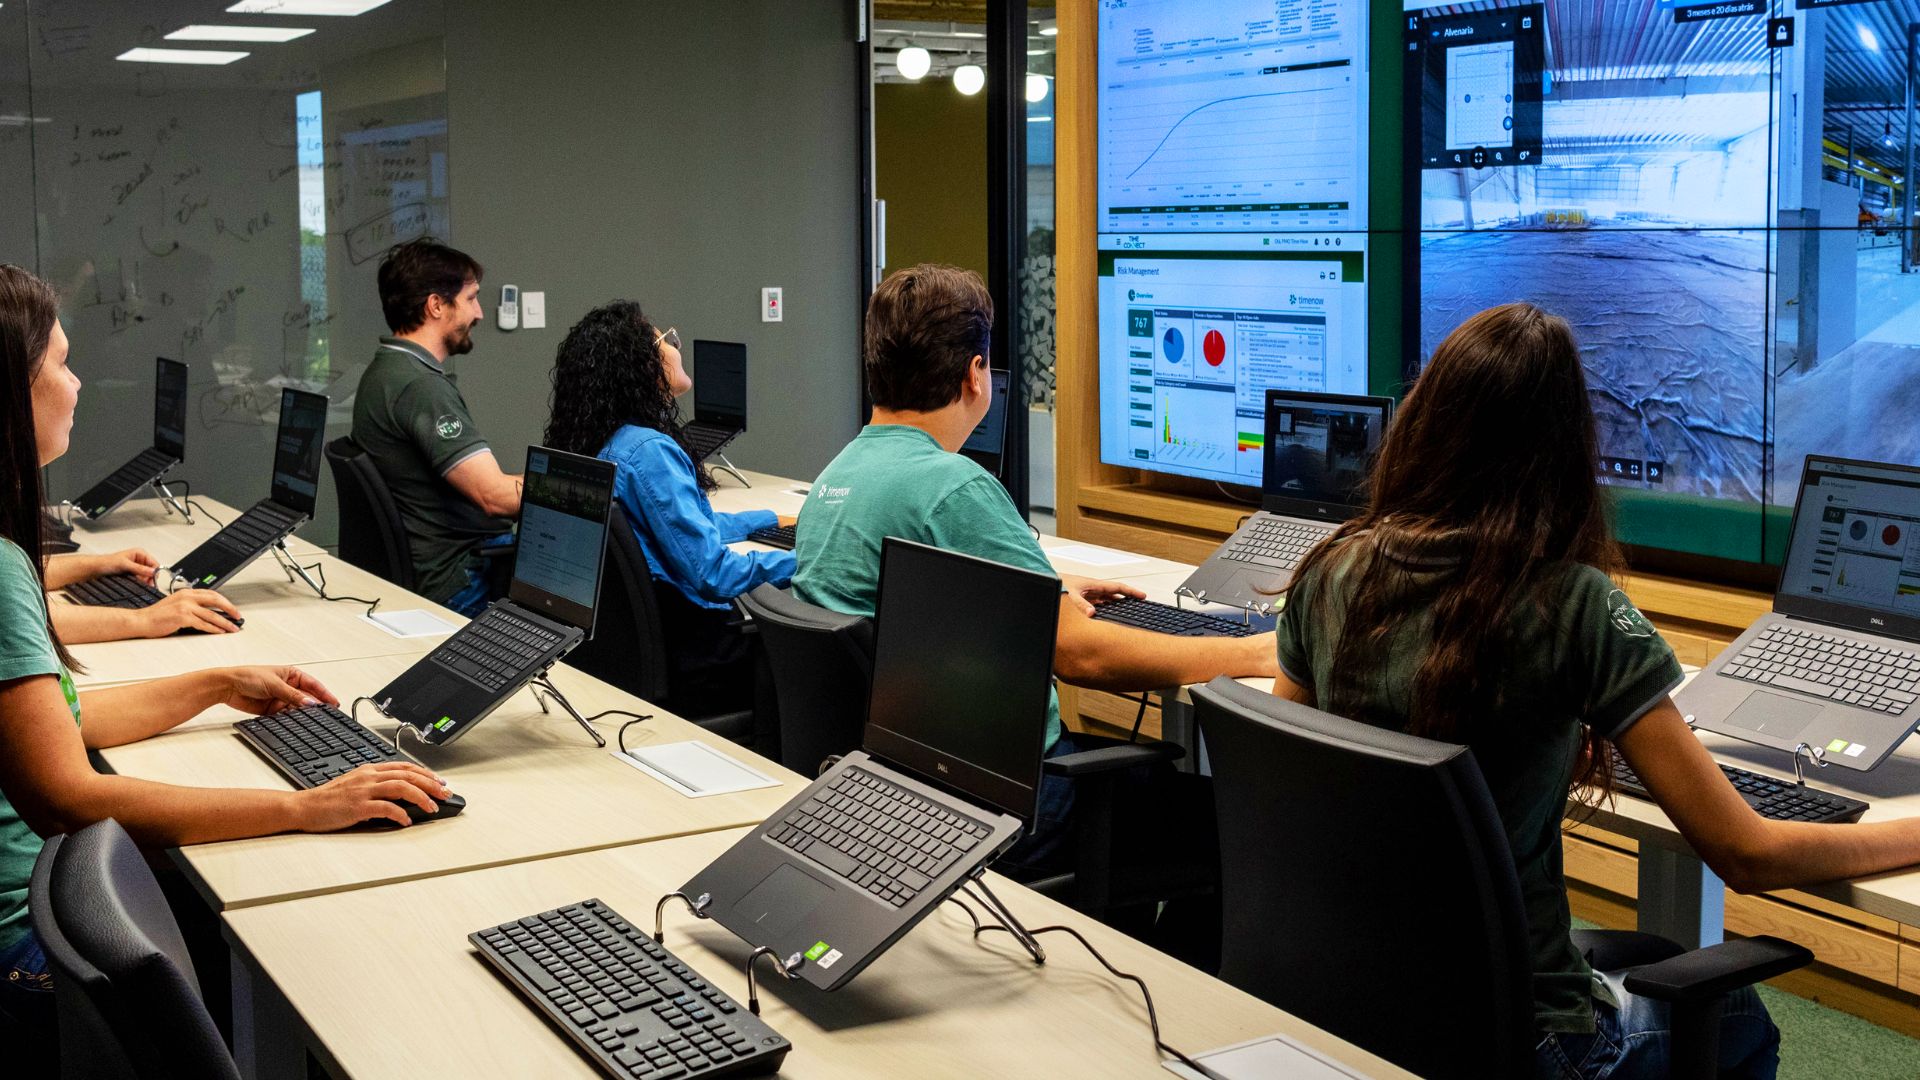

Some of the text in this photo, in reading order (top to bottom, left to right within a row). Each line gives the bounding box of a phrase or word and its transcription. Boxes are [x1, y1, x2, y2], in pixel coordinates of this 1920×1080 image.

[1692, 9, 1711, 17] meses
[1716, 6, 1724, 14] 20
[1725, 5, 1737, 13] dias
[1738, 3, 1754, 11] atrás
[1444, 26, 1474, 38] Alvenaria
[1117, 266, 1160, 276] Risk Management
[1298, 296, 1324, 305] timenow
[1134, 317, 1148, 329] 767
[827, 486, 851, 497] timenow
[1870, 617, 1884, 626] DELL
